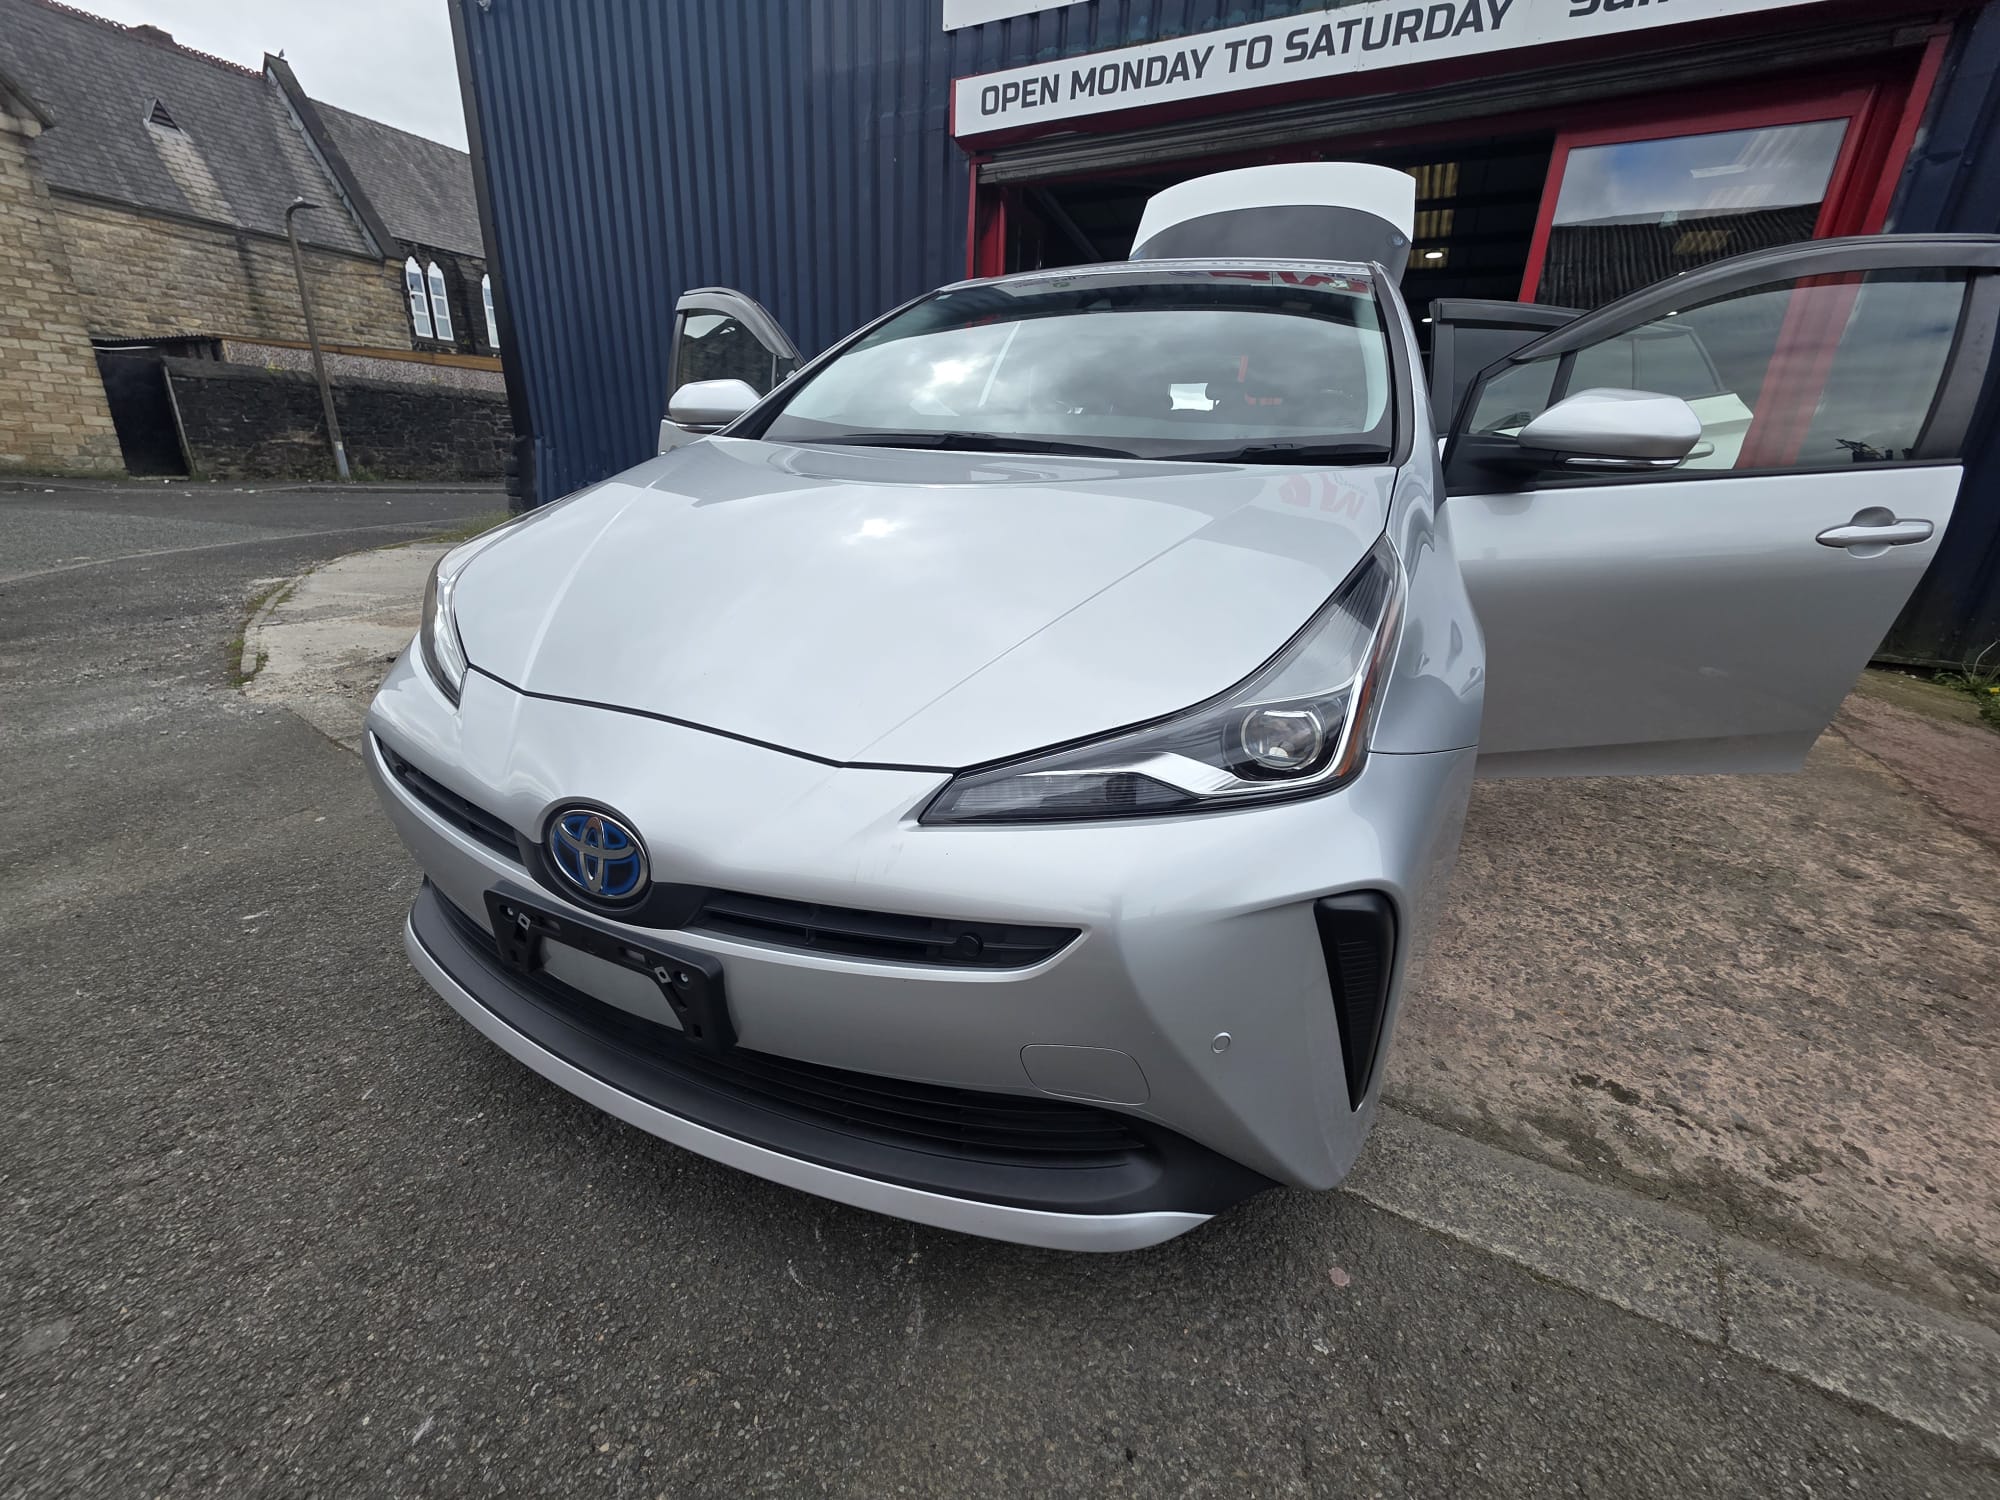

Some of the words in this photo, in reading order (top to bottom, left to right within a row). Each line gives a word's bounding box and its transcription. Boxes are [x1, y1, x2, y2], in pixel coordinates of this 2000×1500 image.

[981, 73, 1060, 116] OPEN
[1070, 46, 1214, 100] MONDAY
[1225, 34, 1273, 73] TO
[1283, 0, 1513, 64] SATURDAY
